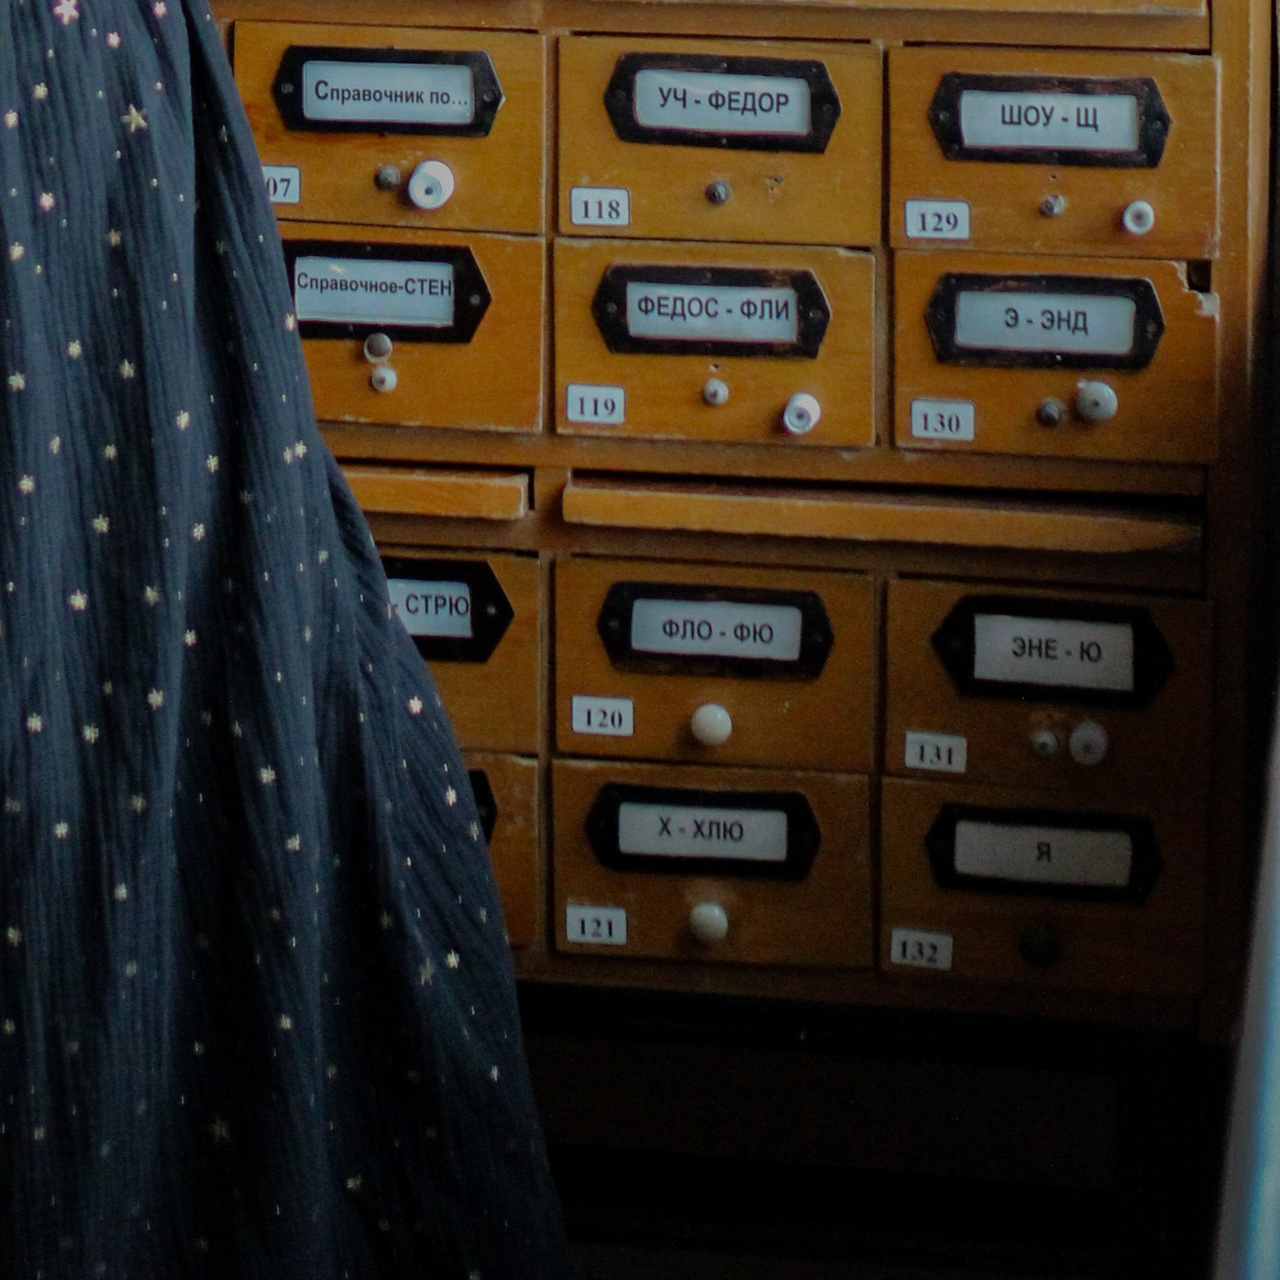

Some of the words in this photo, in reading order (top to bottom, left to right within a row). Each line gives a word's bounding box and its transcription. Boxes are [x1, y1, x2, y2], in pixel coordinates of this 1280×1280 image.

[315, 80, 423, 104] Справочник
[659, 88, 686, 108] УЧ
[708, 92, 789, 115] ФЕДОР
[1002, 105, 1053, 127] ШОУ
[1077, 108, 1098, 132] Щ
[584, 201, 620, 218] 118
[921, 213, 958, 231] 129
[638, 296, 718, 321] ФЕДОС
[741, 300, 789, 320] ФЛИ
[1005, 308, 1019, 328] Э
[1041, 310, 1088, 335] ЭНД
[580, 398, 615, 416] 119
[924, 414, 960, 432] 130
[663, 620, 712, 640] ФЛО
[734, 624, 773, 643] ФЮ
[1013, 638, 1057, 659] ЭНЕ
[1080, 642, 1101, 662] Ю
[587, 710, 622, 727] 120
[660, 818, 671, 836] Х
[694, 820, 743, 841] ХЛЮ
[1037, 843, 1051, 862] Я
